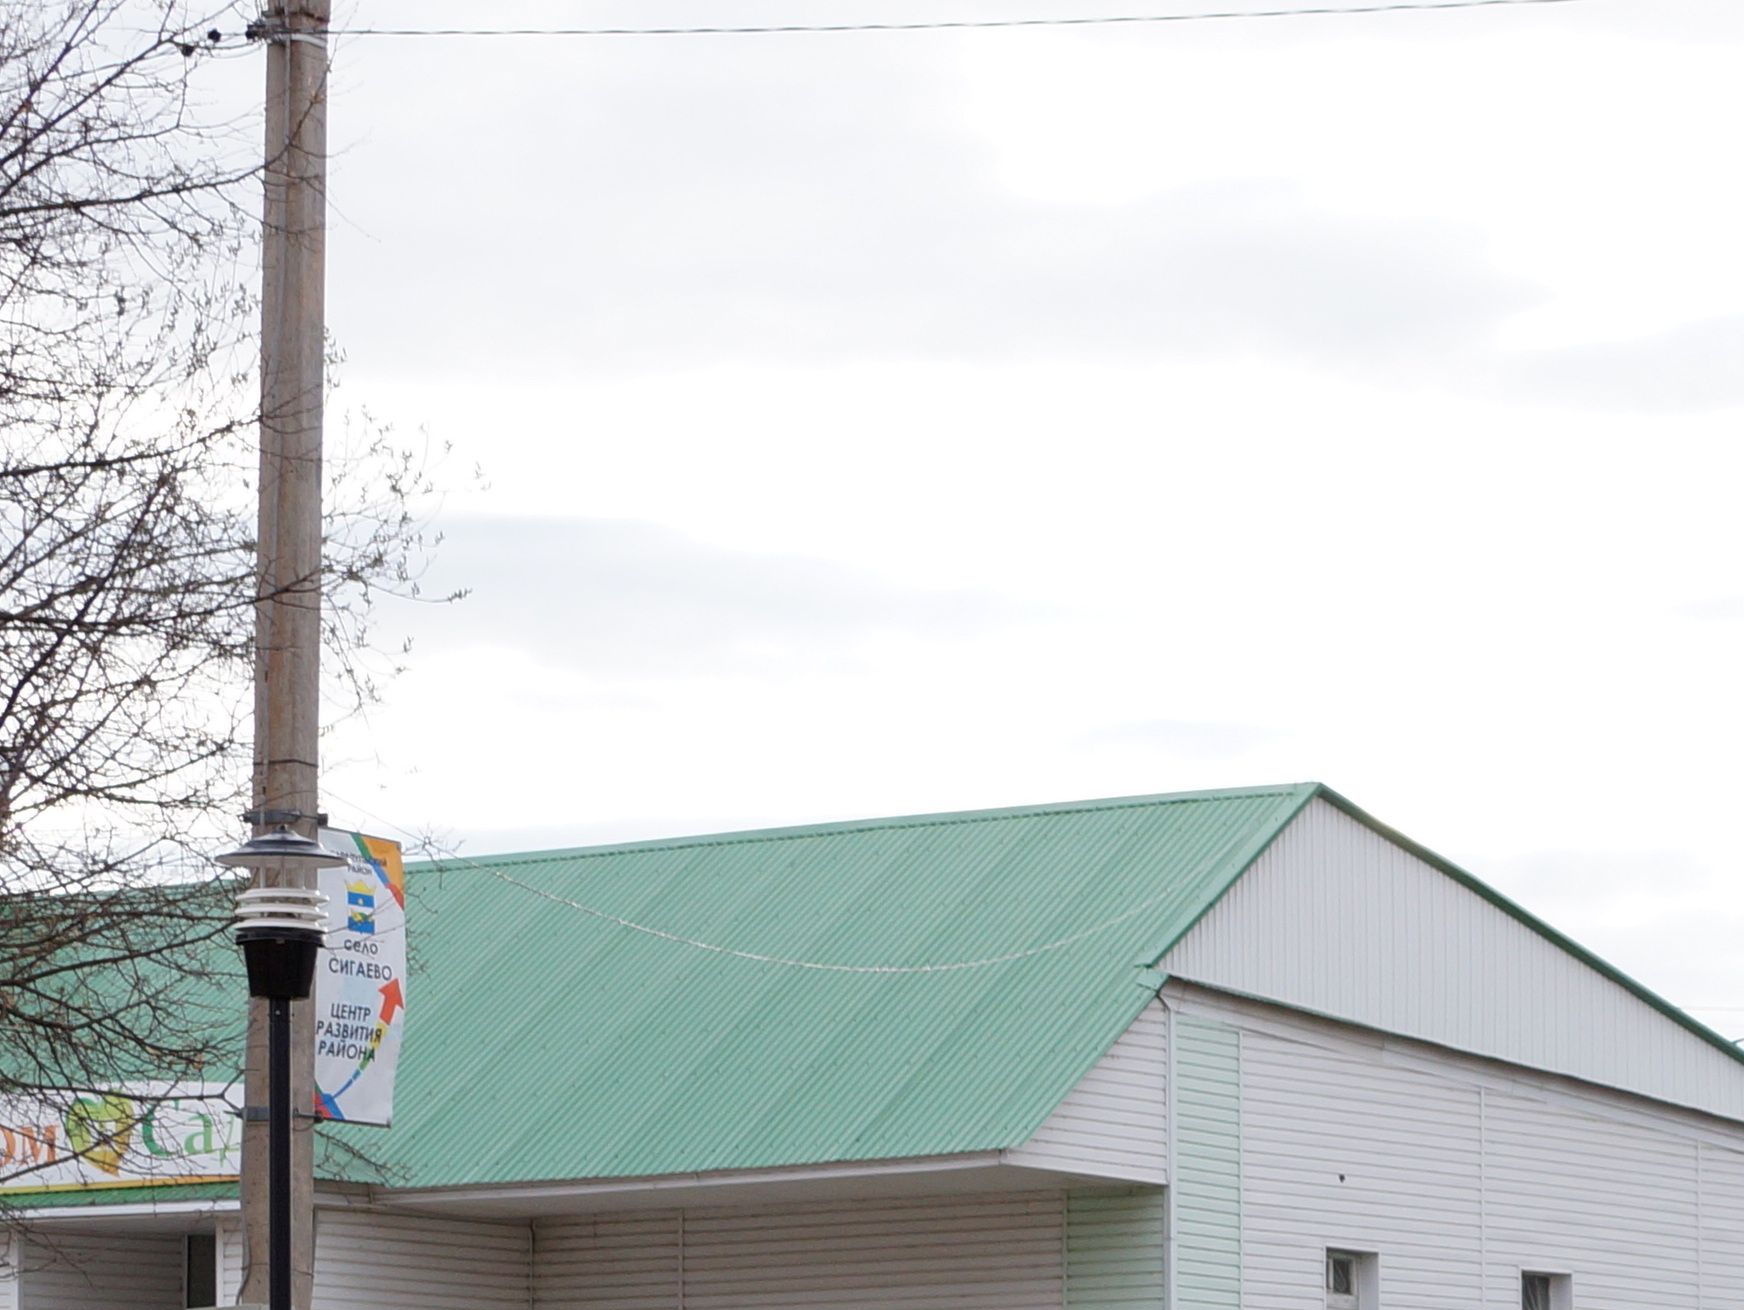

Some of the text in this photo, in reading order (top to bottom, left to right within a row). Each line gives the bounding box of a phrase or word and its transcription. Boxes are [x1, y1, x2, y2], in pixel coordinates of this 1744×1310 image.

[344, 939, 378, 955] село
[328, 957, 392, 981] СИГАЕВО
[331, 1003, 371, 1022] ЦЕНТР
[316, 1020, 382, 1043] РАЗВИТИЯ
[317, 1040, 376, 1062] РАЙОНА
